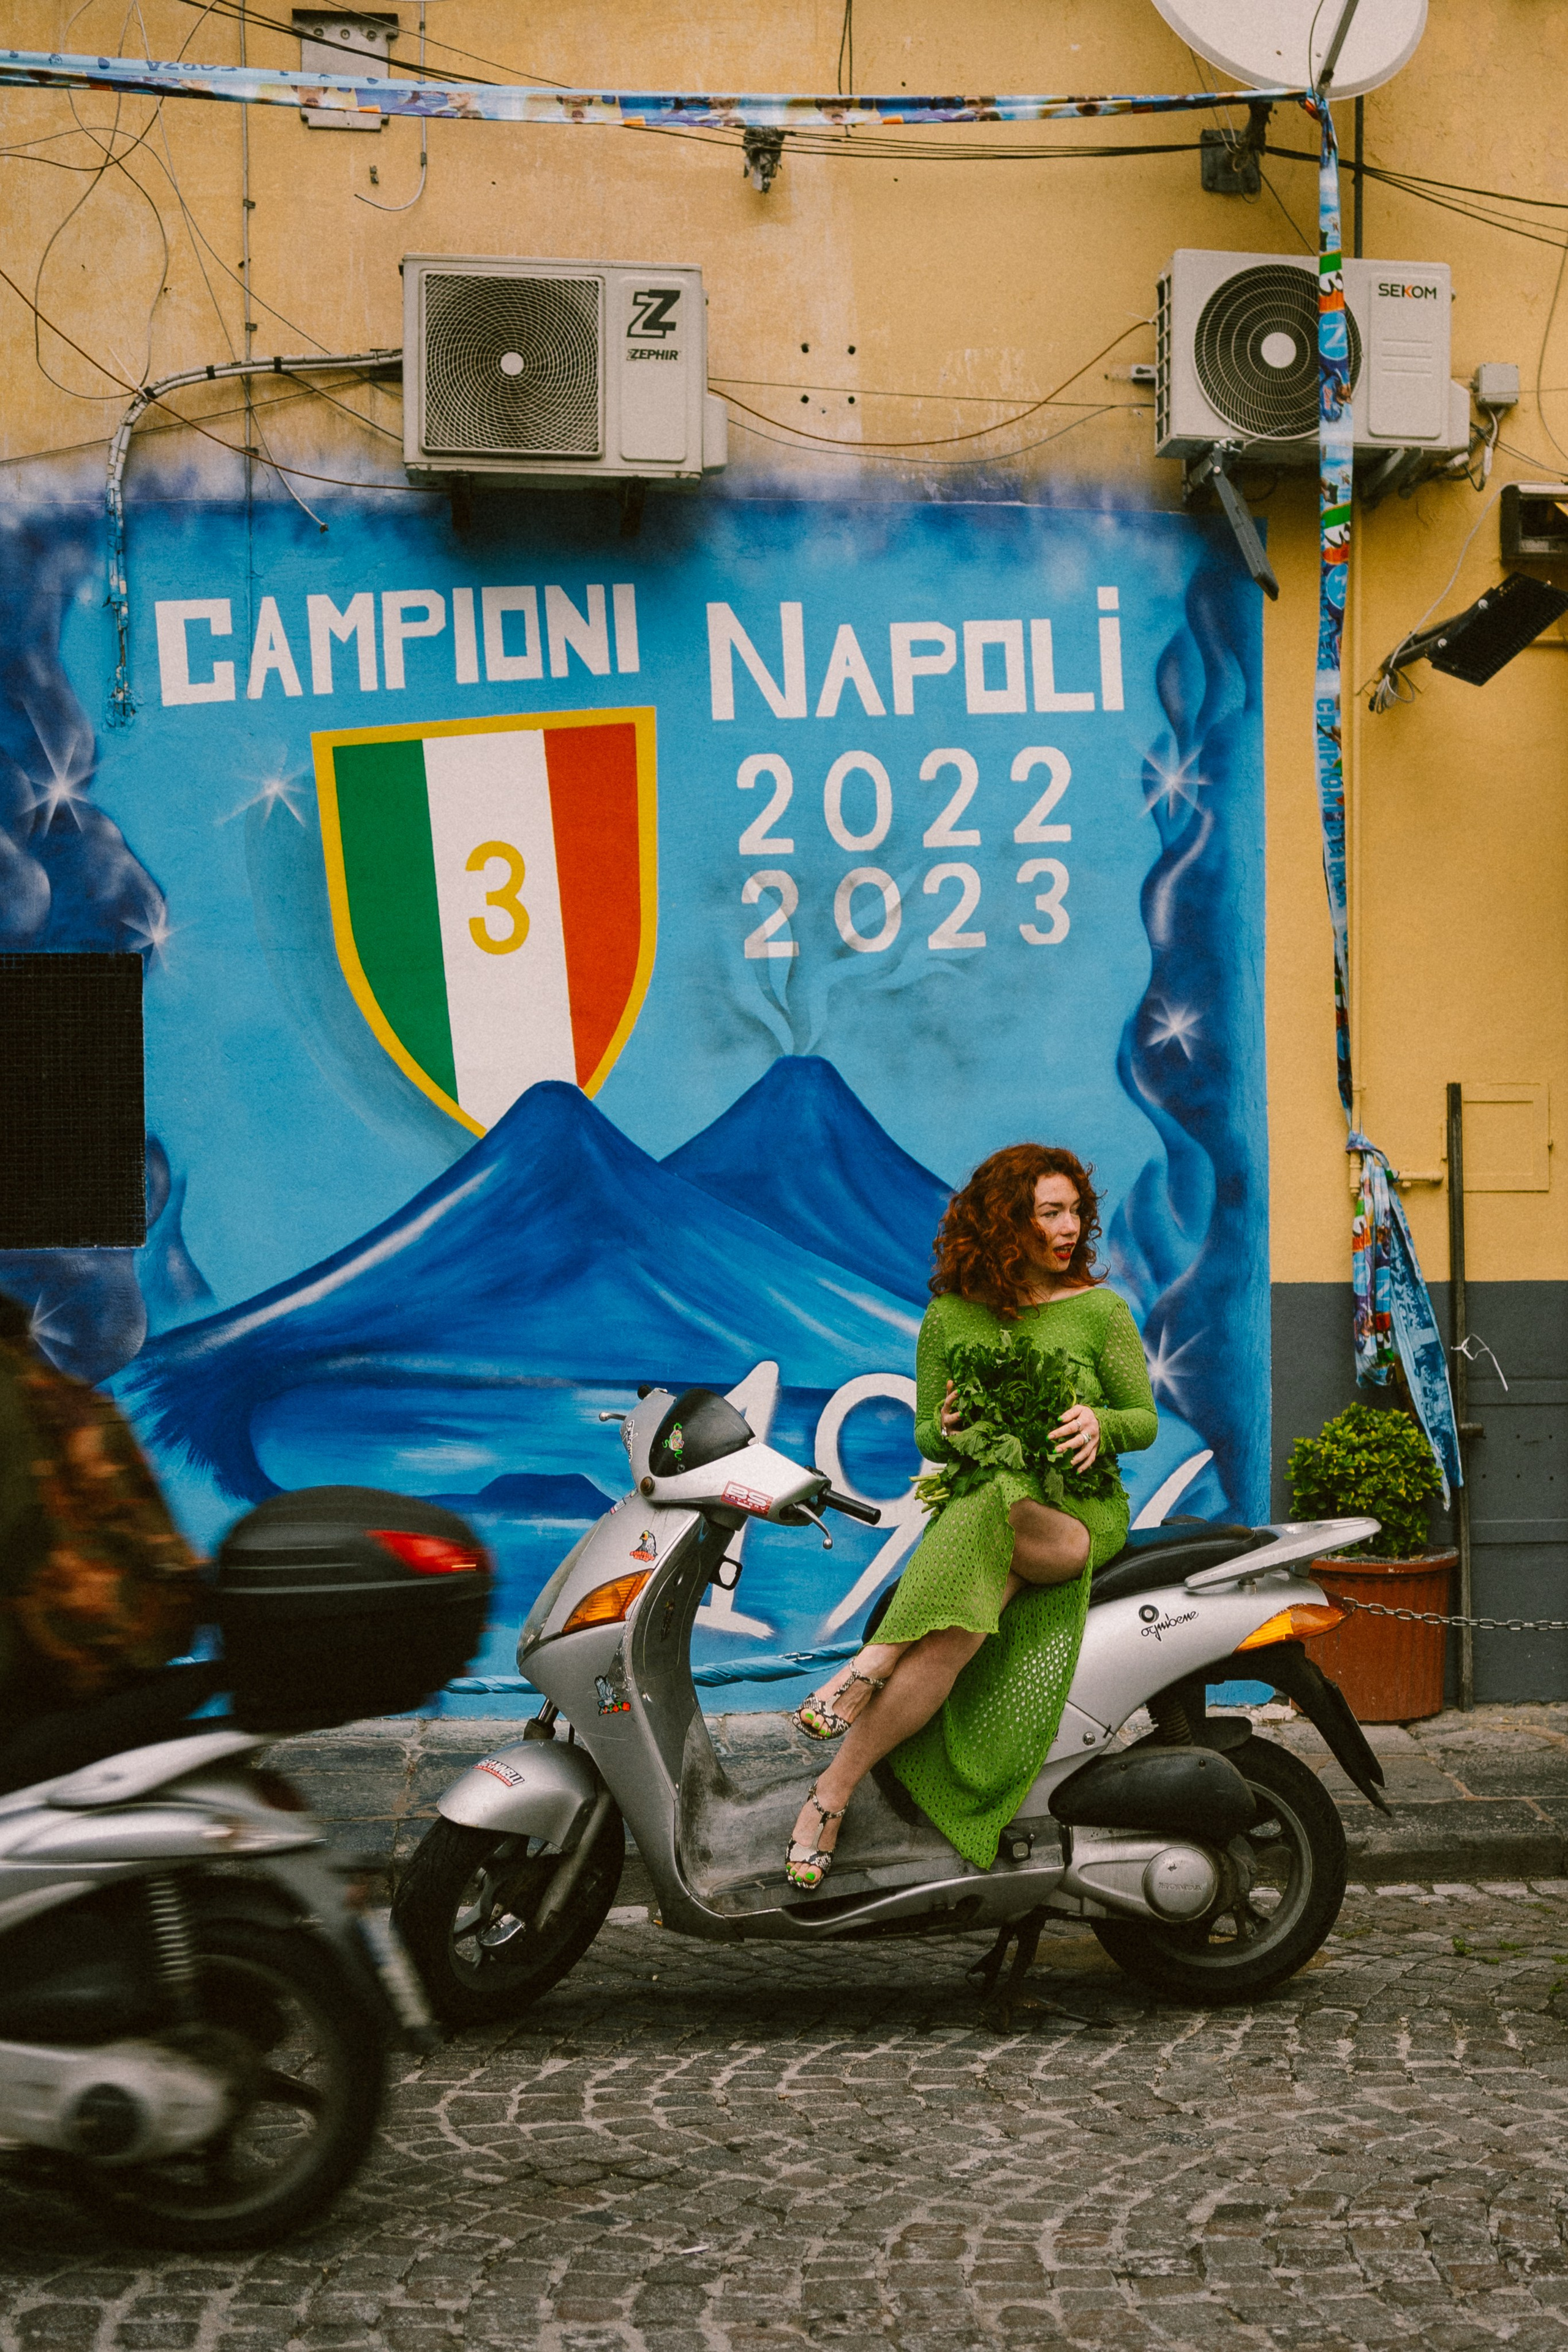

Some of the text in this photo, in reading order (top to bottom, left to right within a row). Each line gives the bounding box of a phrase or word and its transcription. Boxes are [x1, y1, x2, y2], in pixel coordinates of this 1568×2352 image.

[1378, 283, 1436, 300] SEKOM
[627, 349, 679, 361] ZEPHIR
[155, 583, 639, 706] CAMPIONI
[736, 746, 1072, 855] 2022
[465, 840, 530, 955] 3
[742, 858, 1070, 959] 2023
[726, 1483, 767, 1507] BS
[478, 1759, 524, 1785] GIANNELLI
[1158, 1882, 1202, 1891] HONDA
